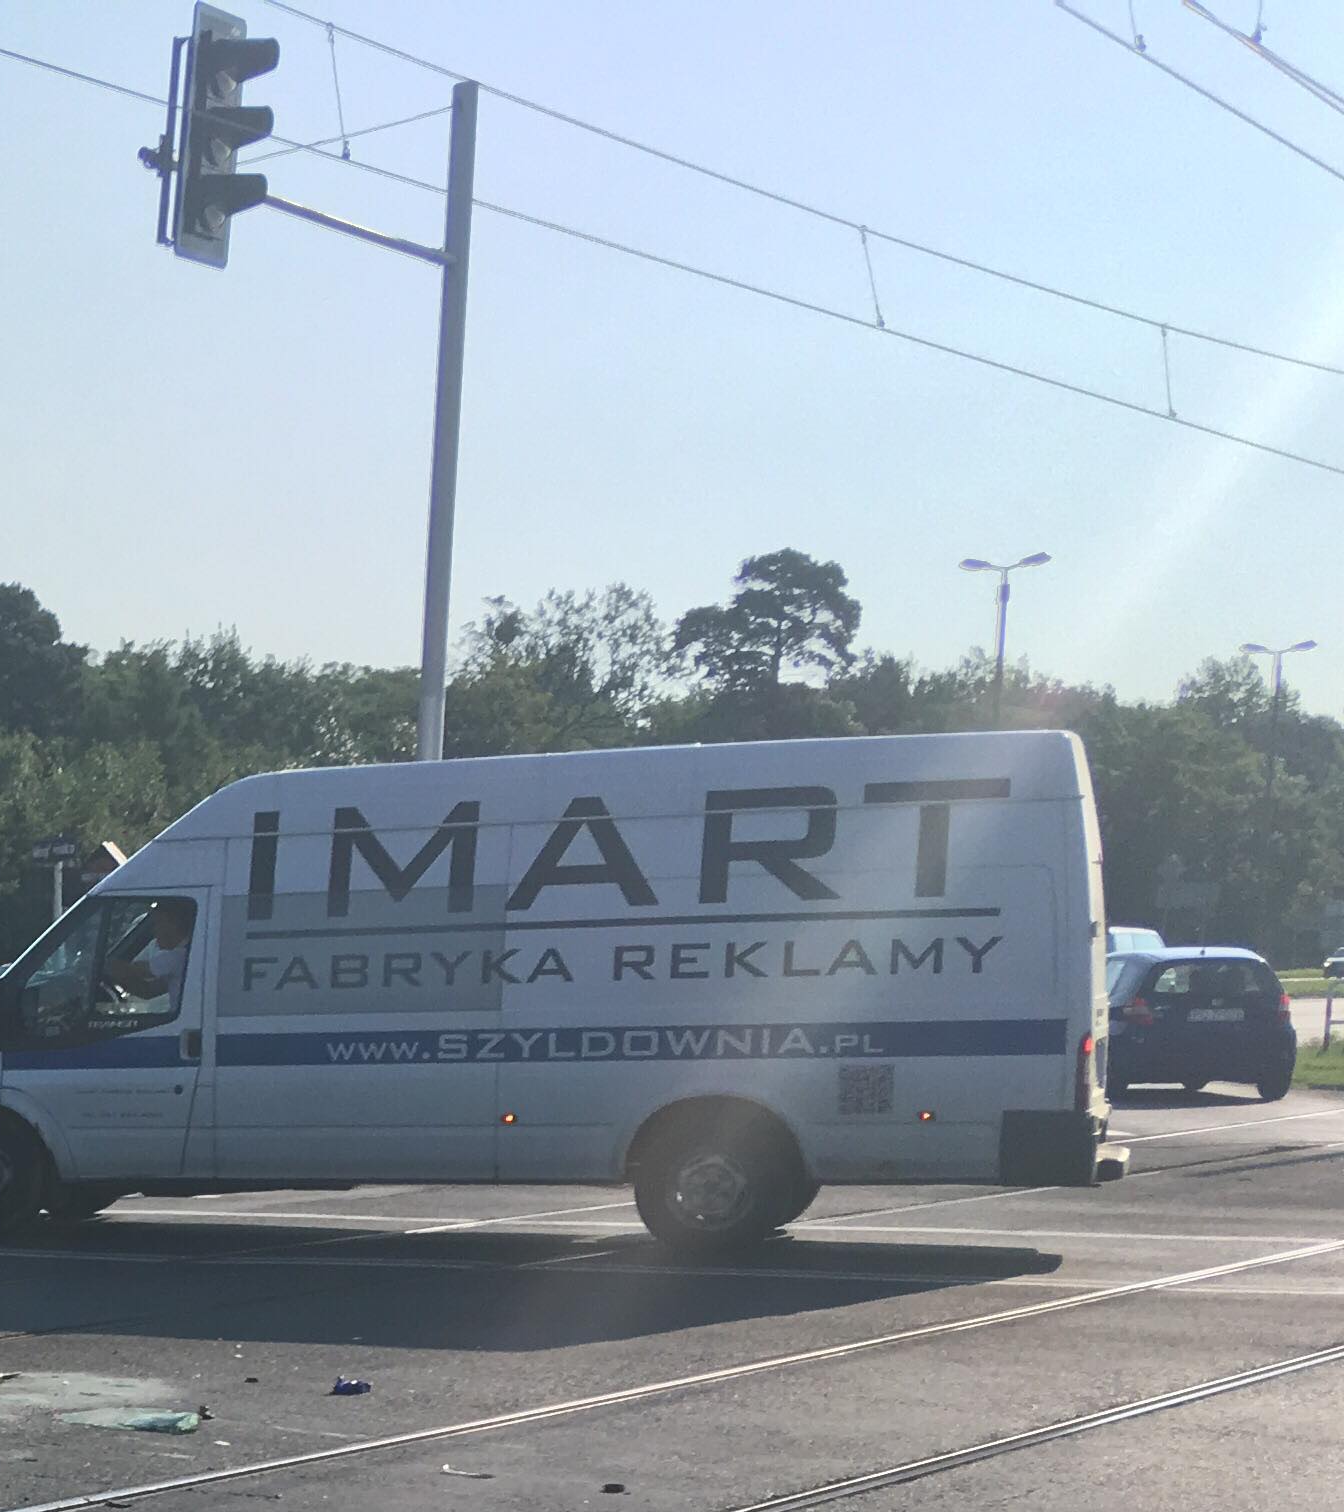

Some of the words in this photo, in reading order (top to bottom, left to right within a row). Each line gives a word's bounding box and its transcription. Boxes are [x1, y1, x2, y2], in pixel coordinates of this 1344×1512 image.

[247, 778, 1011, 921] IMART
[242, 947, 574, 992] FABRYKA
[613, 935, 1004, 981] REKLAMY
